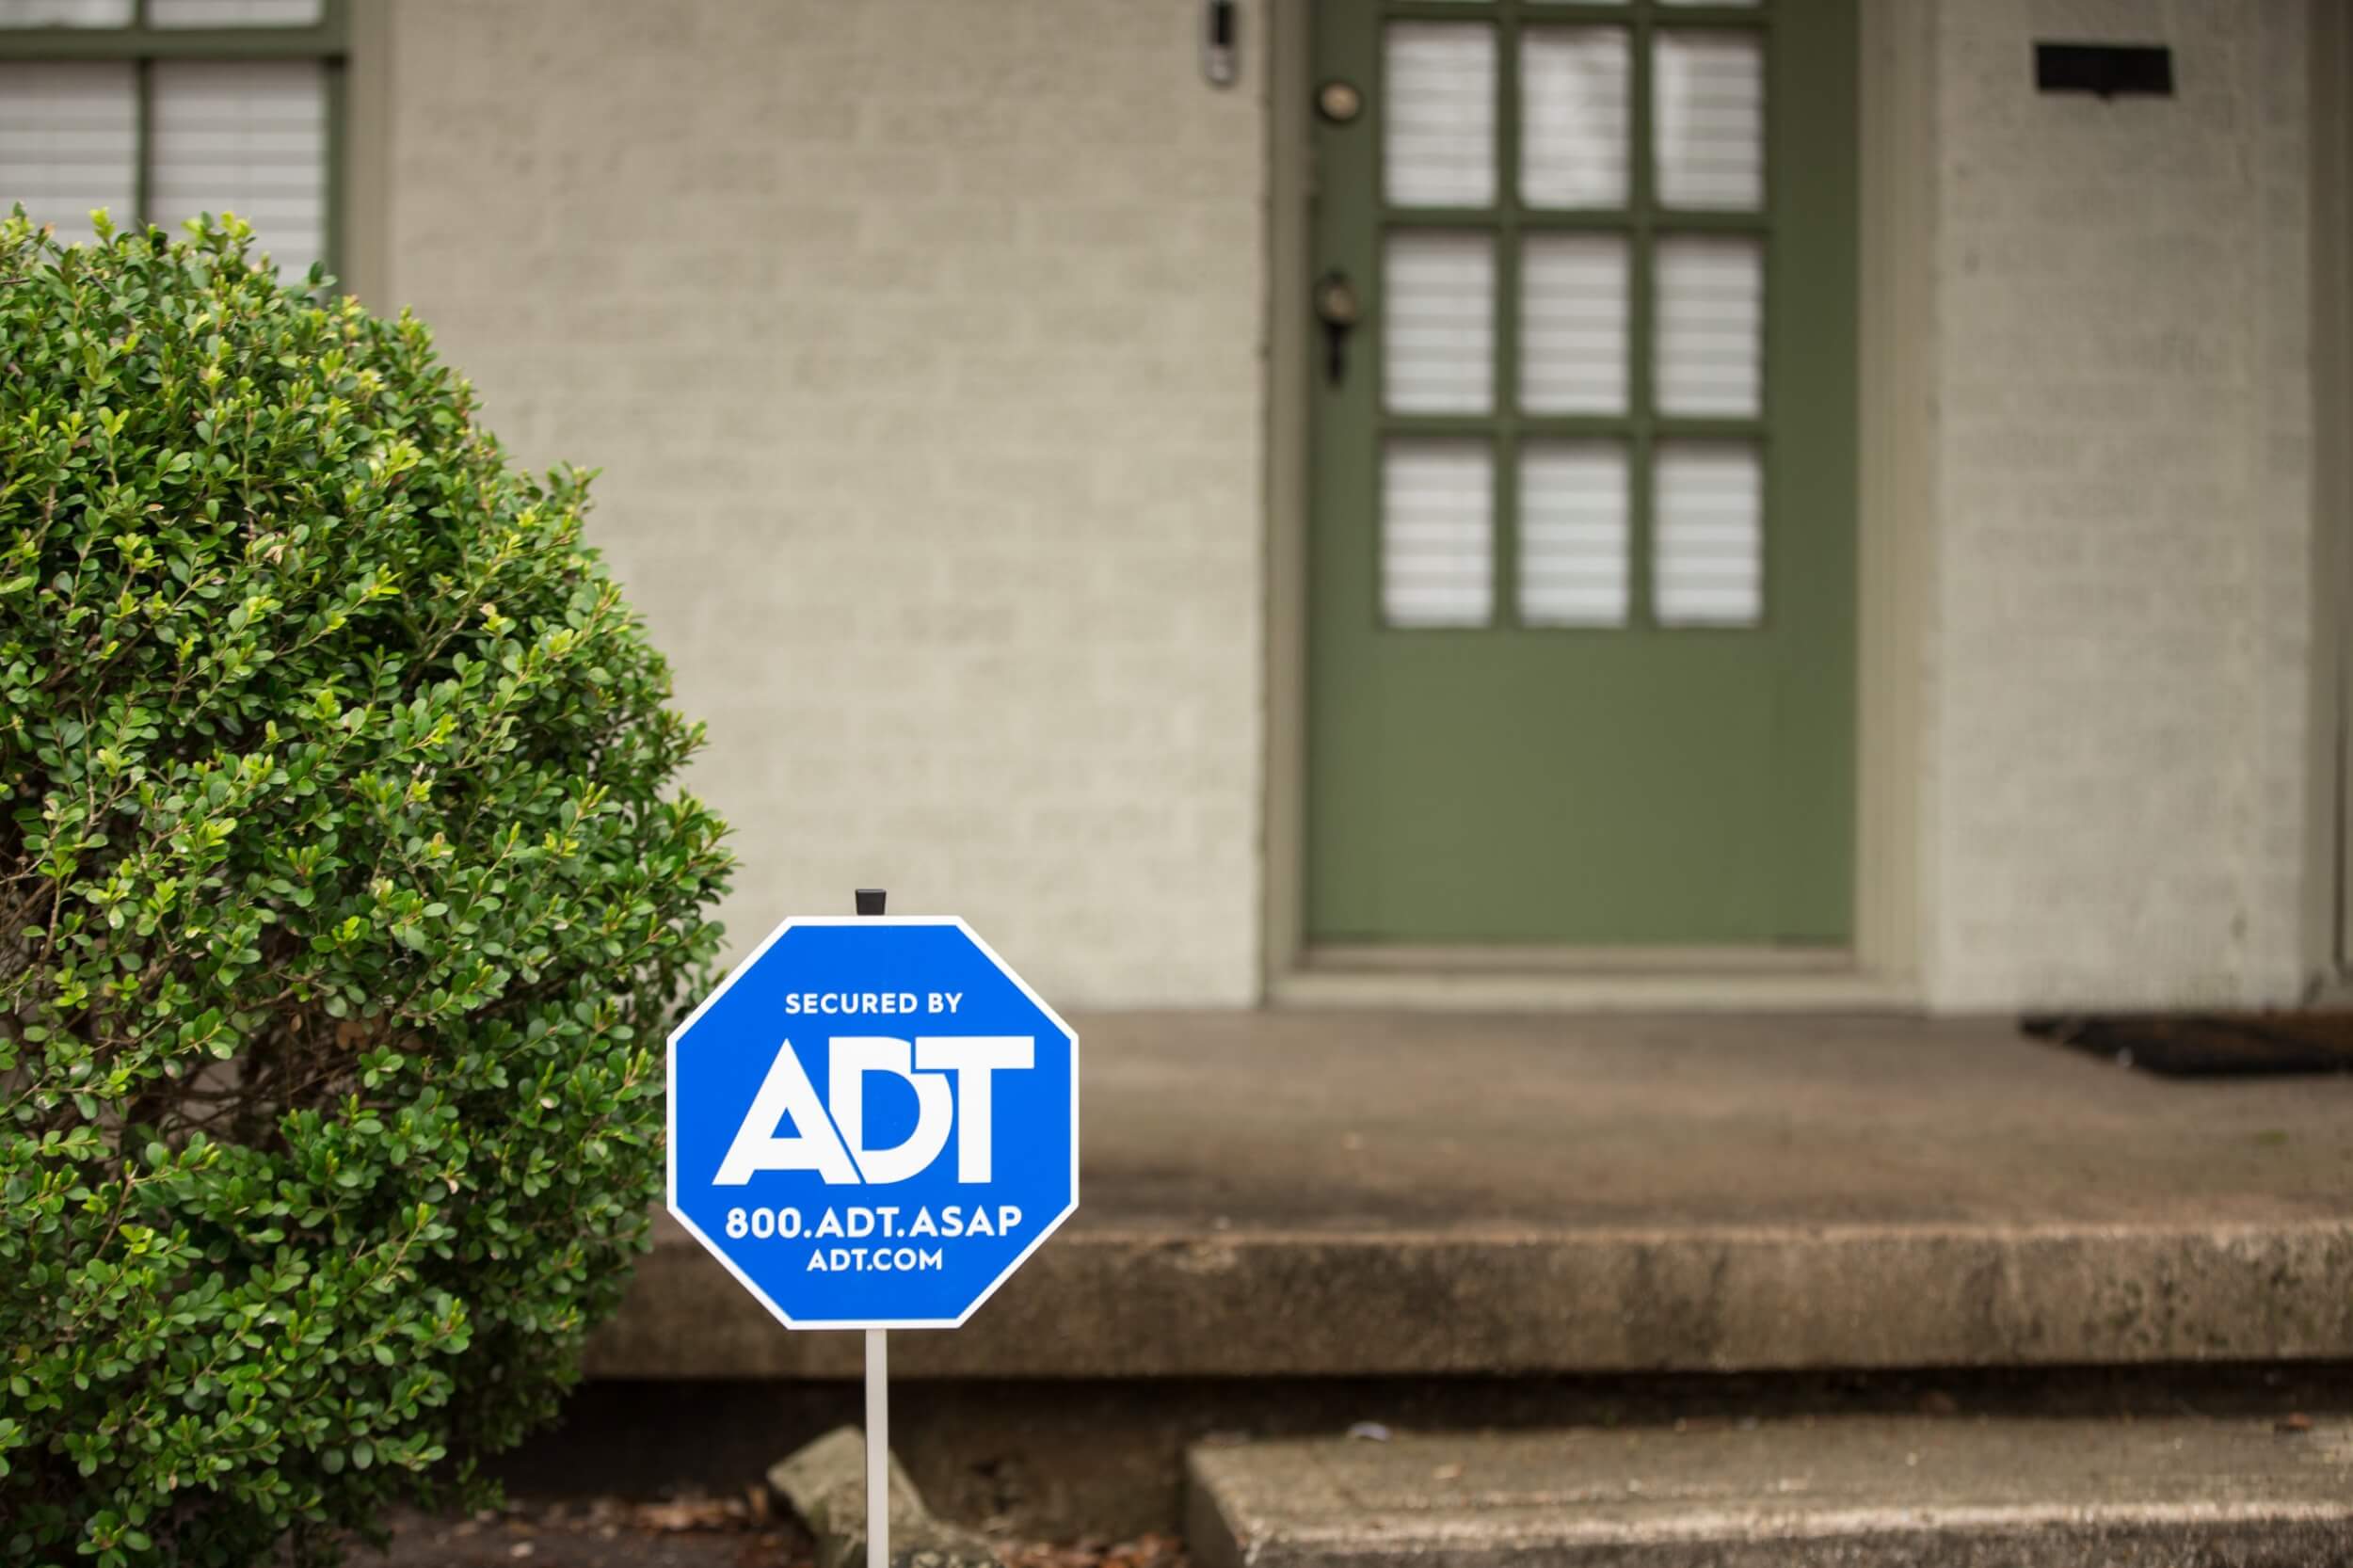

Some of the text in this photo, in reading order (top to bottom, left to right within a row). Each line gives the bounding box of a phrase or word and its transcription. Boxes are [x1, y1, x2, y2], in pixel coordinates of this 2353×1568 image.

[786, 993, 963, 1014] SECURED BY
[712, 1035, 1035, 1185] ADT
[726, 1206, 1022, 1239] 800.ADT.ASAP
[807, 1248, 942, 1271] ADT.COM
